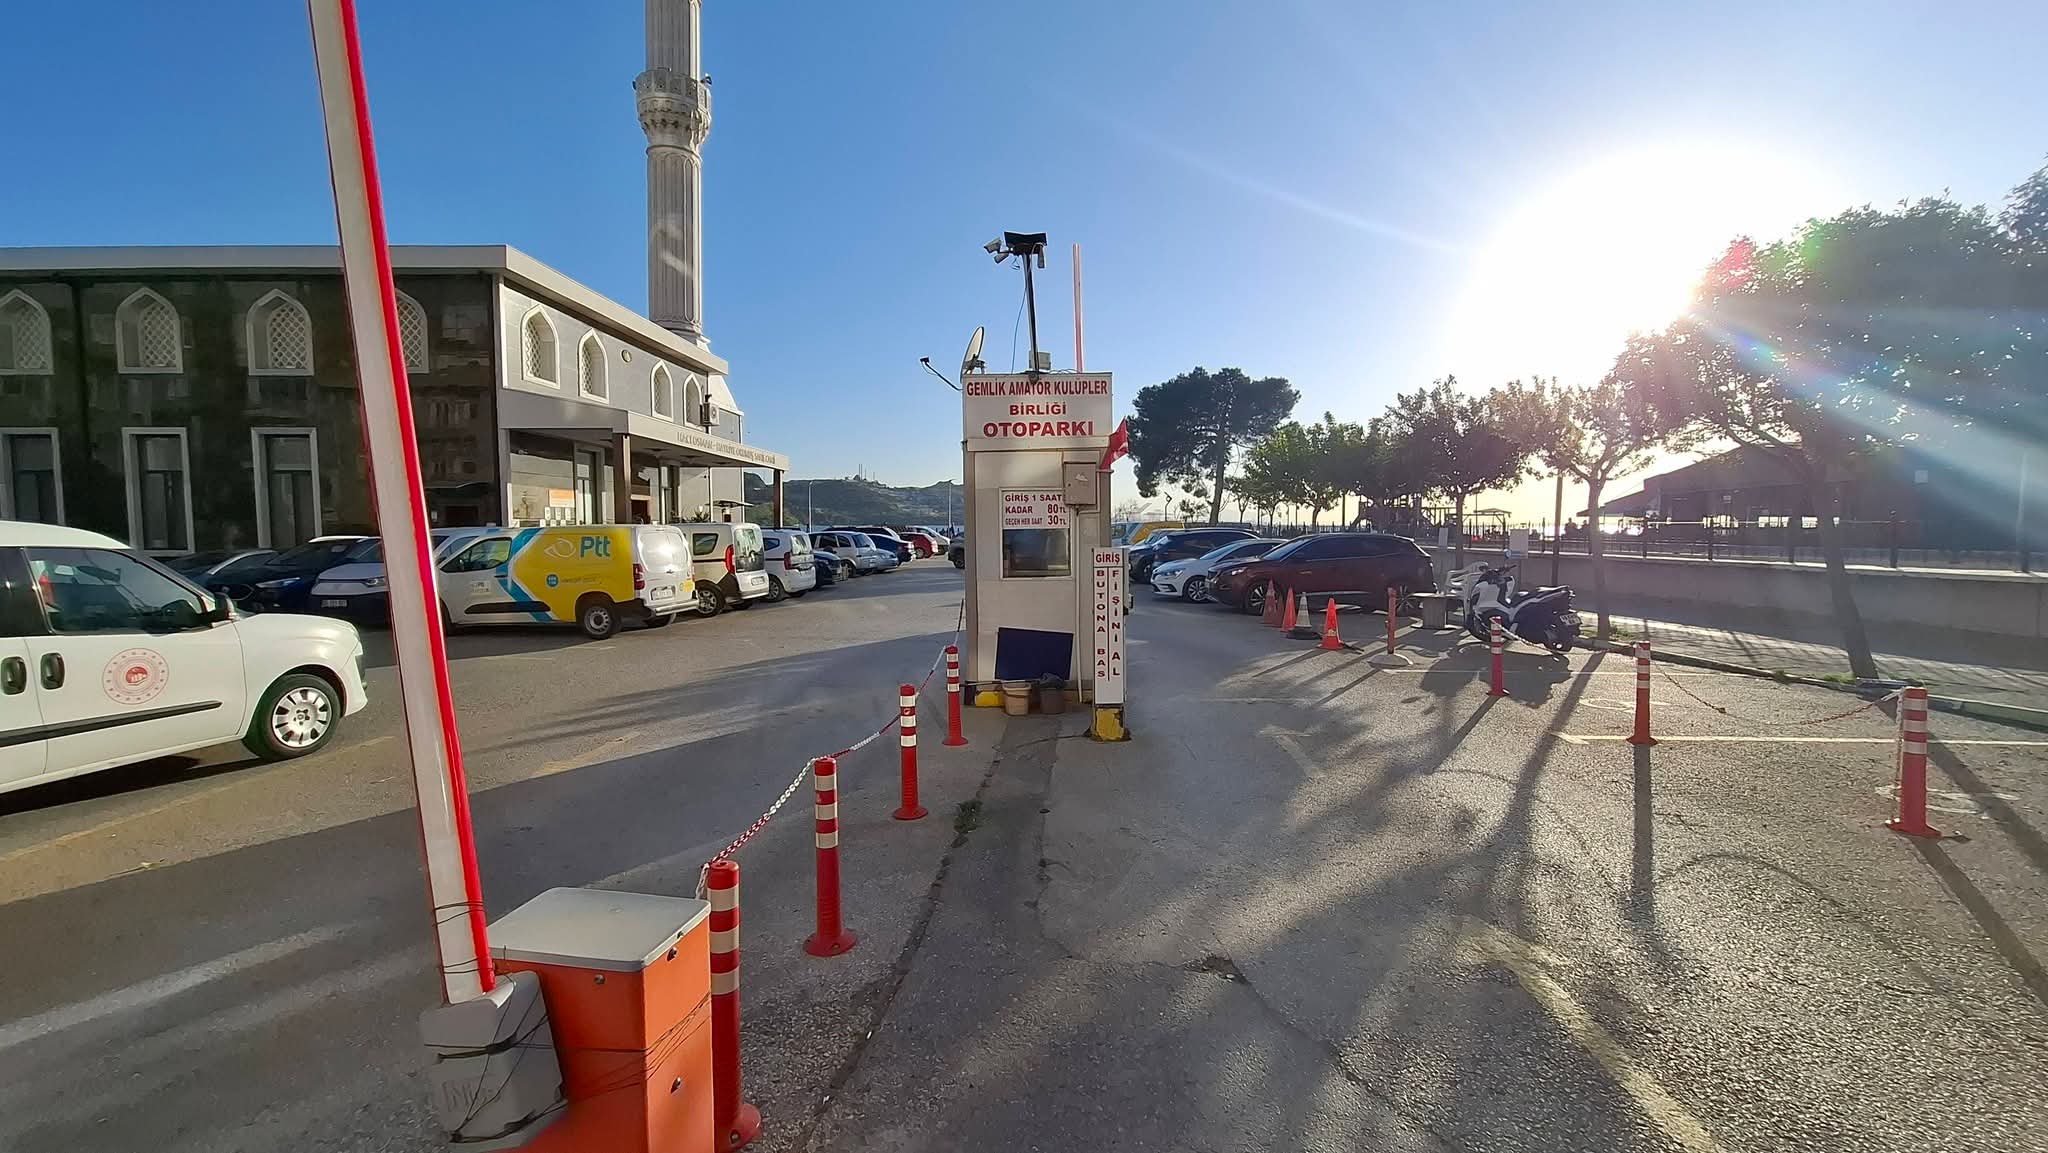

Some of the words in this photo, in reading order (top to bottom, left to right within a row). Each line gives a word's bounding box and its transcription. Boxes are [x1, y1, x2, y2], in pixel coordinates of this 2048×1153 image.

[966, 378, 1006, 396] GEMLİK
[1008, 378, 1051, 396] AMATÖR
[1054, 377, 1108, 395] KULÜPLER
[1009, 401, 1067, 416] BİRLİĞİ
[983, 421, 1094, 438] OTOPARKI
[1005, 492, 1030, 503] GİRİŞ
[1005, 505, 1033, 514] KADAR
[1047, 503, 1059, 514] 80
[1047, 515, 1059, 525] 30
[580, 536, 611, 558] Ptt
[1095, 551, 1121, 565] GİRİŞ
[1096, 569, 1106, 633] BUTONA
[1096, 648, 1106, 678] BAS
[1111, 651, 1121, 676] AL
